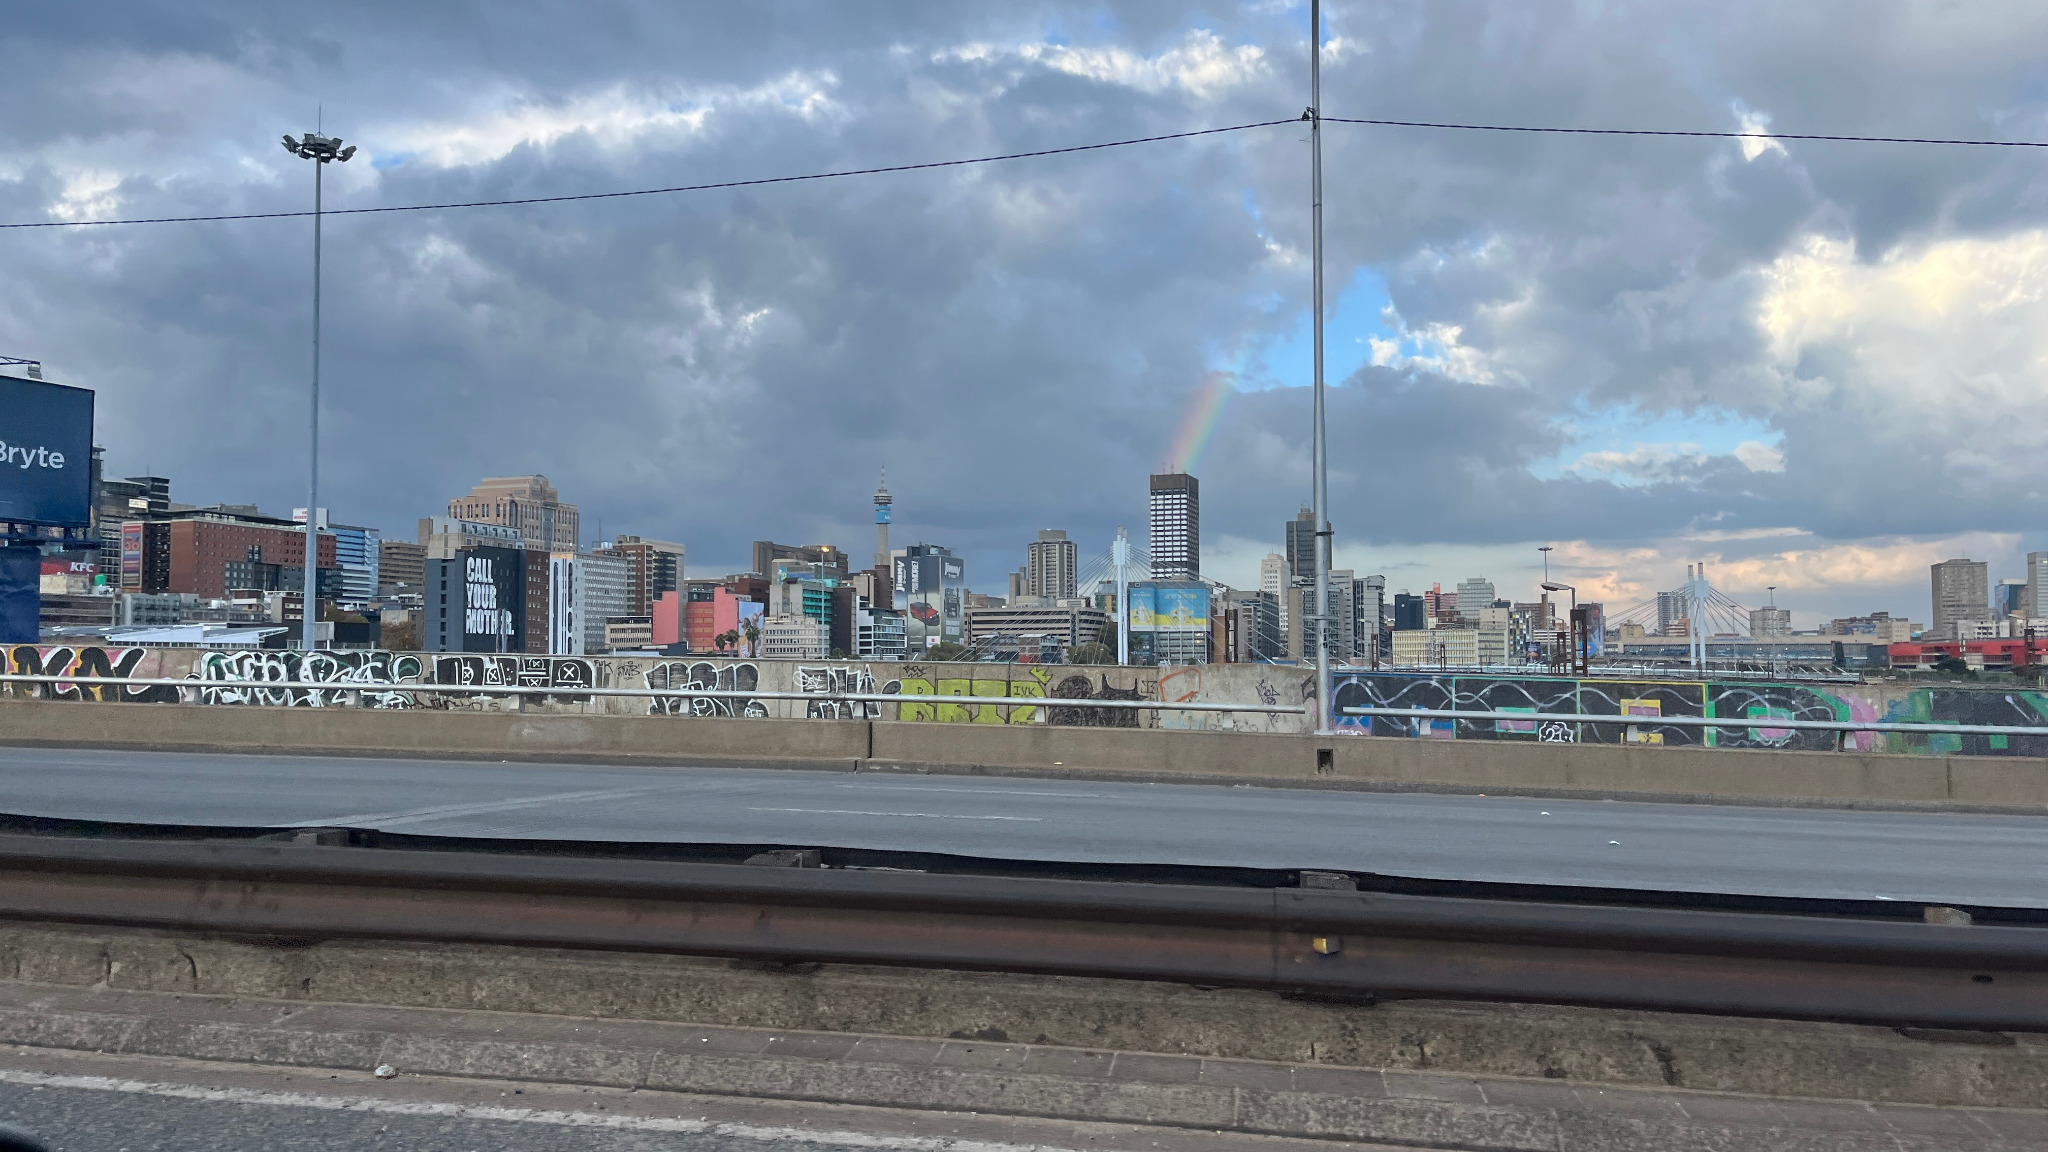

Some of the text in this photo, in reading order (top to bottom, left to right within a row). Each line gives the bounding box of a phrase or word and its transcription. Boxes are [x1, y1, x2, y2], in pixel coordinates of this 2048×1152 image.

[69, 562, 95, 573] KFC
[466, 557, 493, 583] CALL
[466, 583, 497, 609] YOUR
